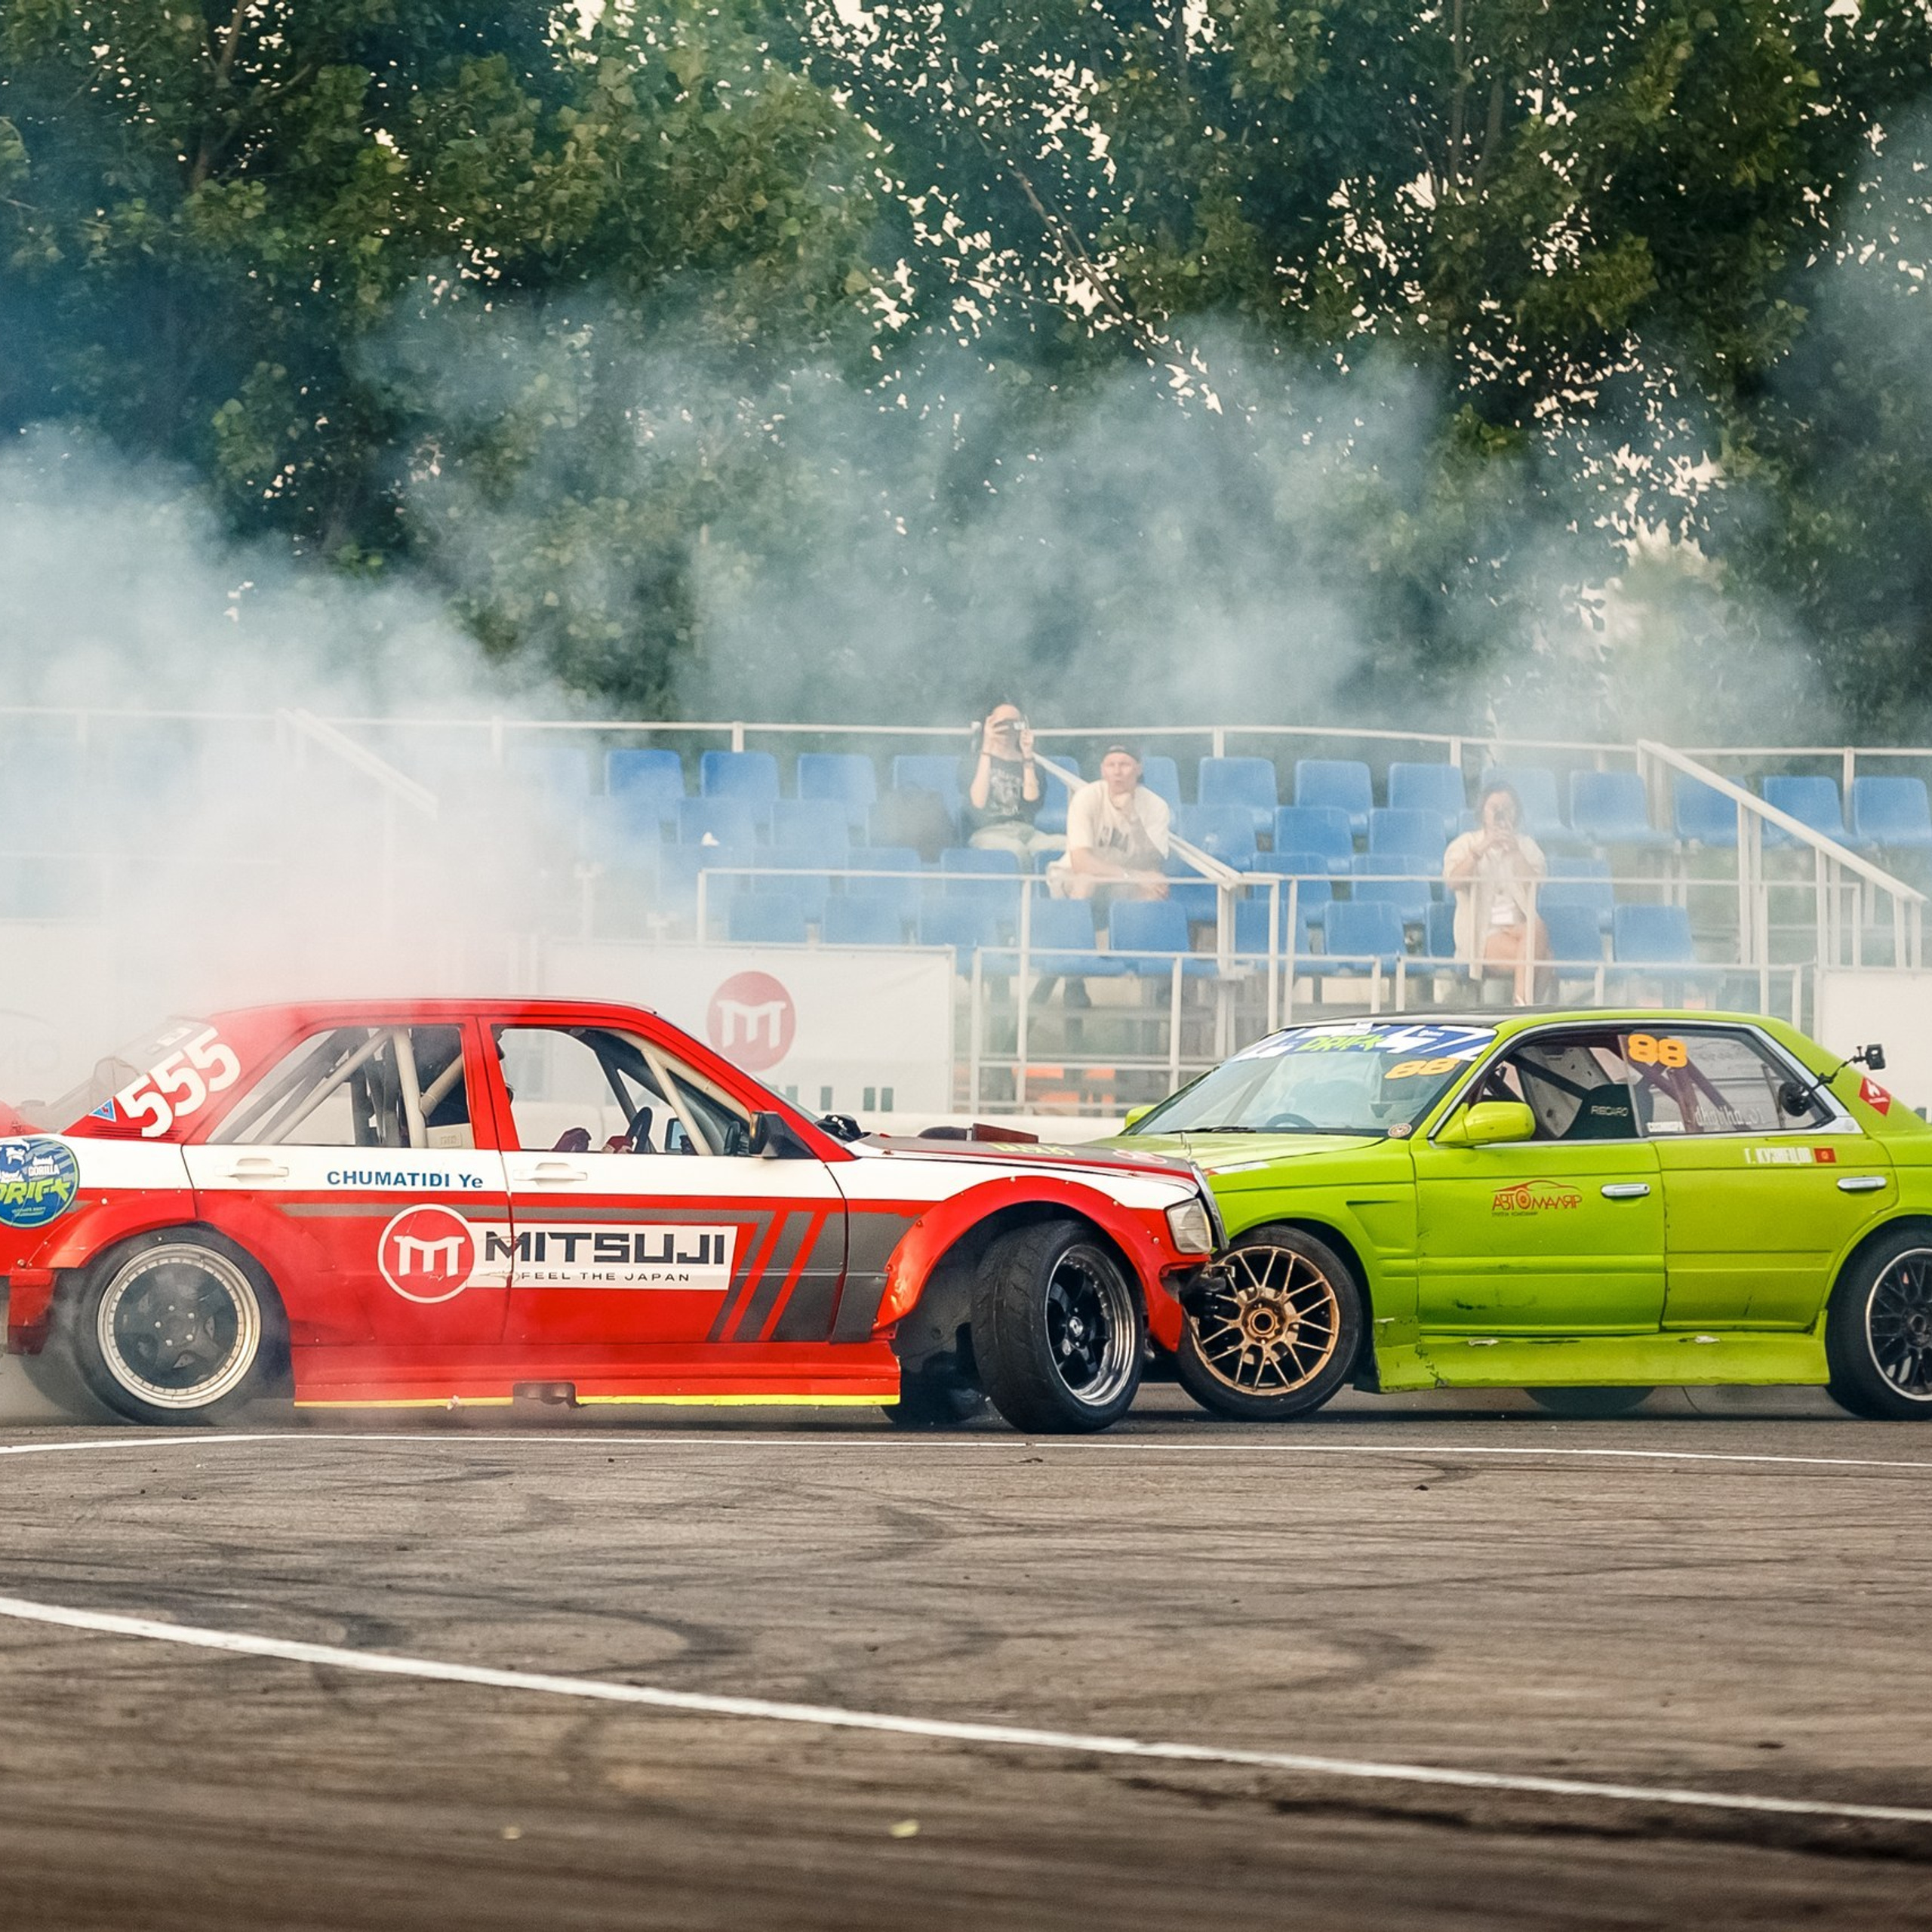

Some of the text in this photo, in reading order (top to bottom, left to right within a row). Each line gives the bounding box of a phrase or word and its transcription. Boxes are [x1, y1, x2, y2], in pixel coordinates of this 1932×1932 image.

[1628, 1033, 1687, 1068] 88
[1384, 1057, 1460, 1079] 88
[115, 1027, 241, 1137] 555
[327, 1171, 484, 1189] CHUMATIDI Ye
[485, 1231, 724, 1264] MITSUJI
[521, 1271, 690, 1282] FEEL THE JAPAN
